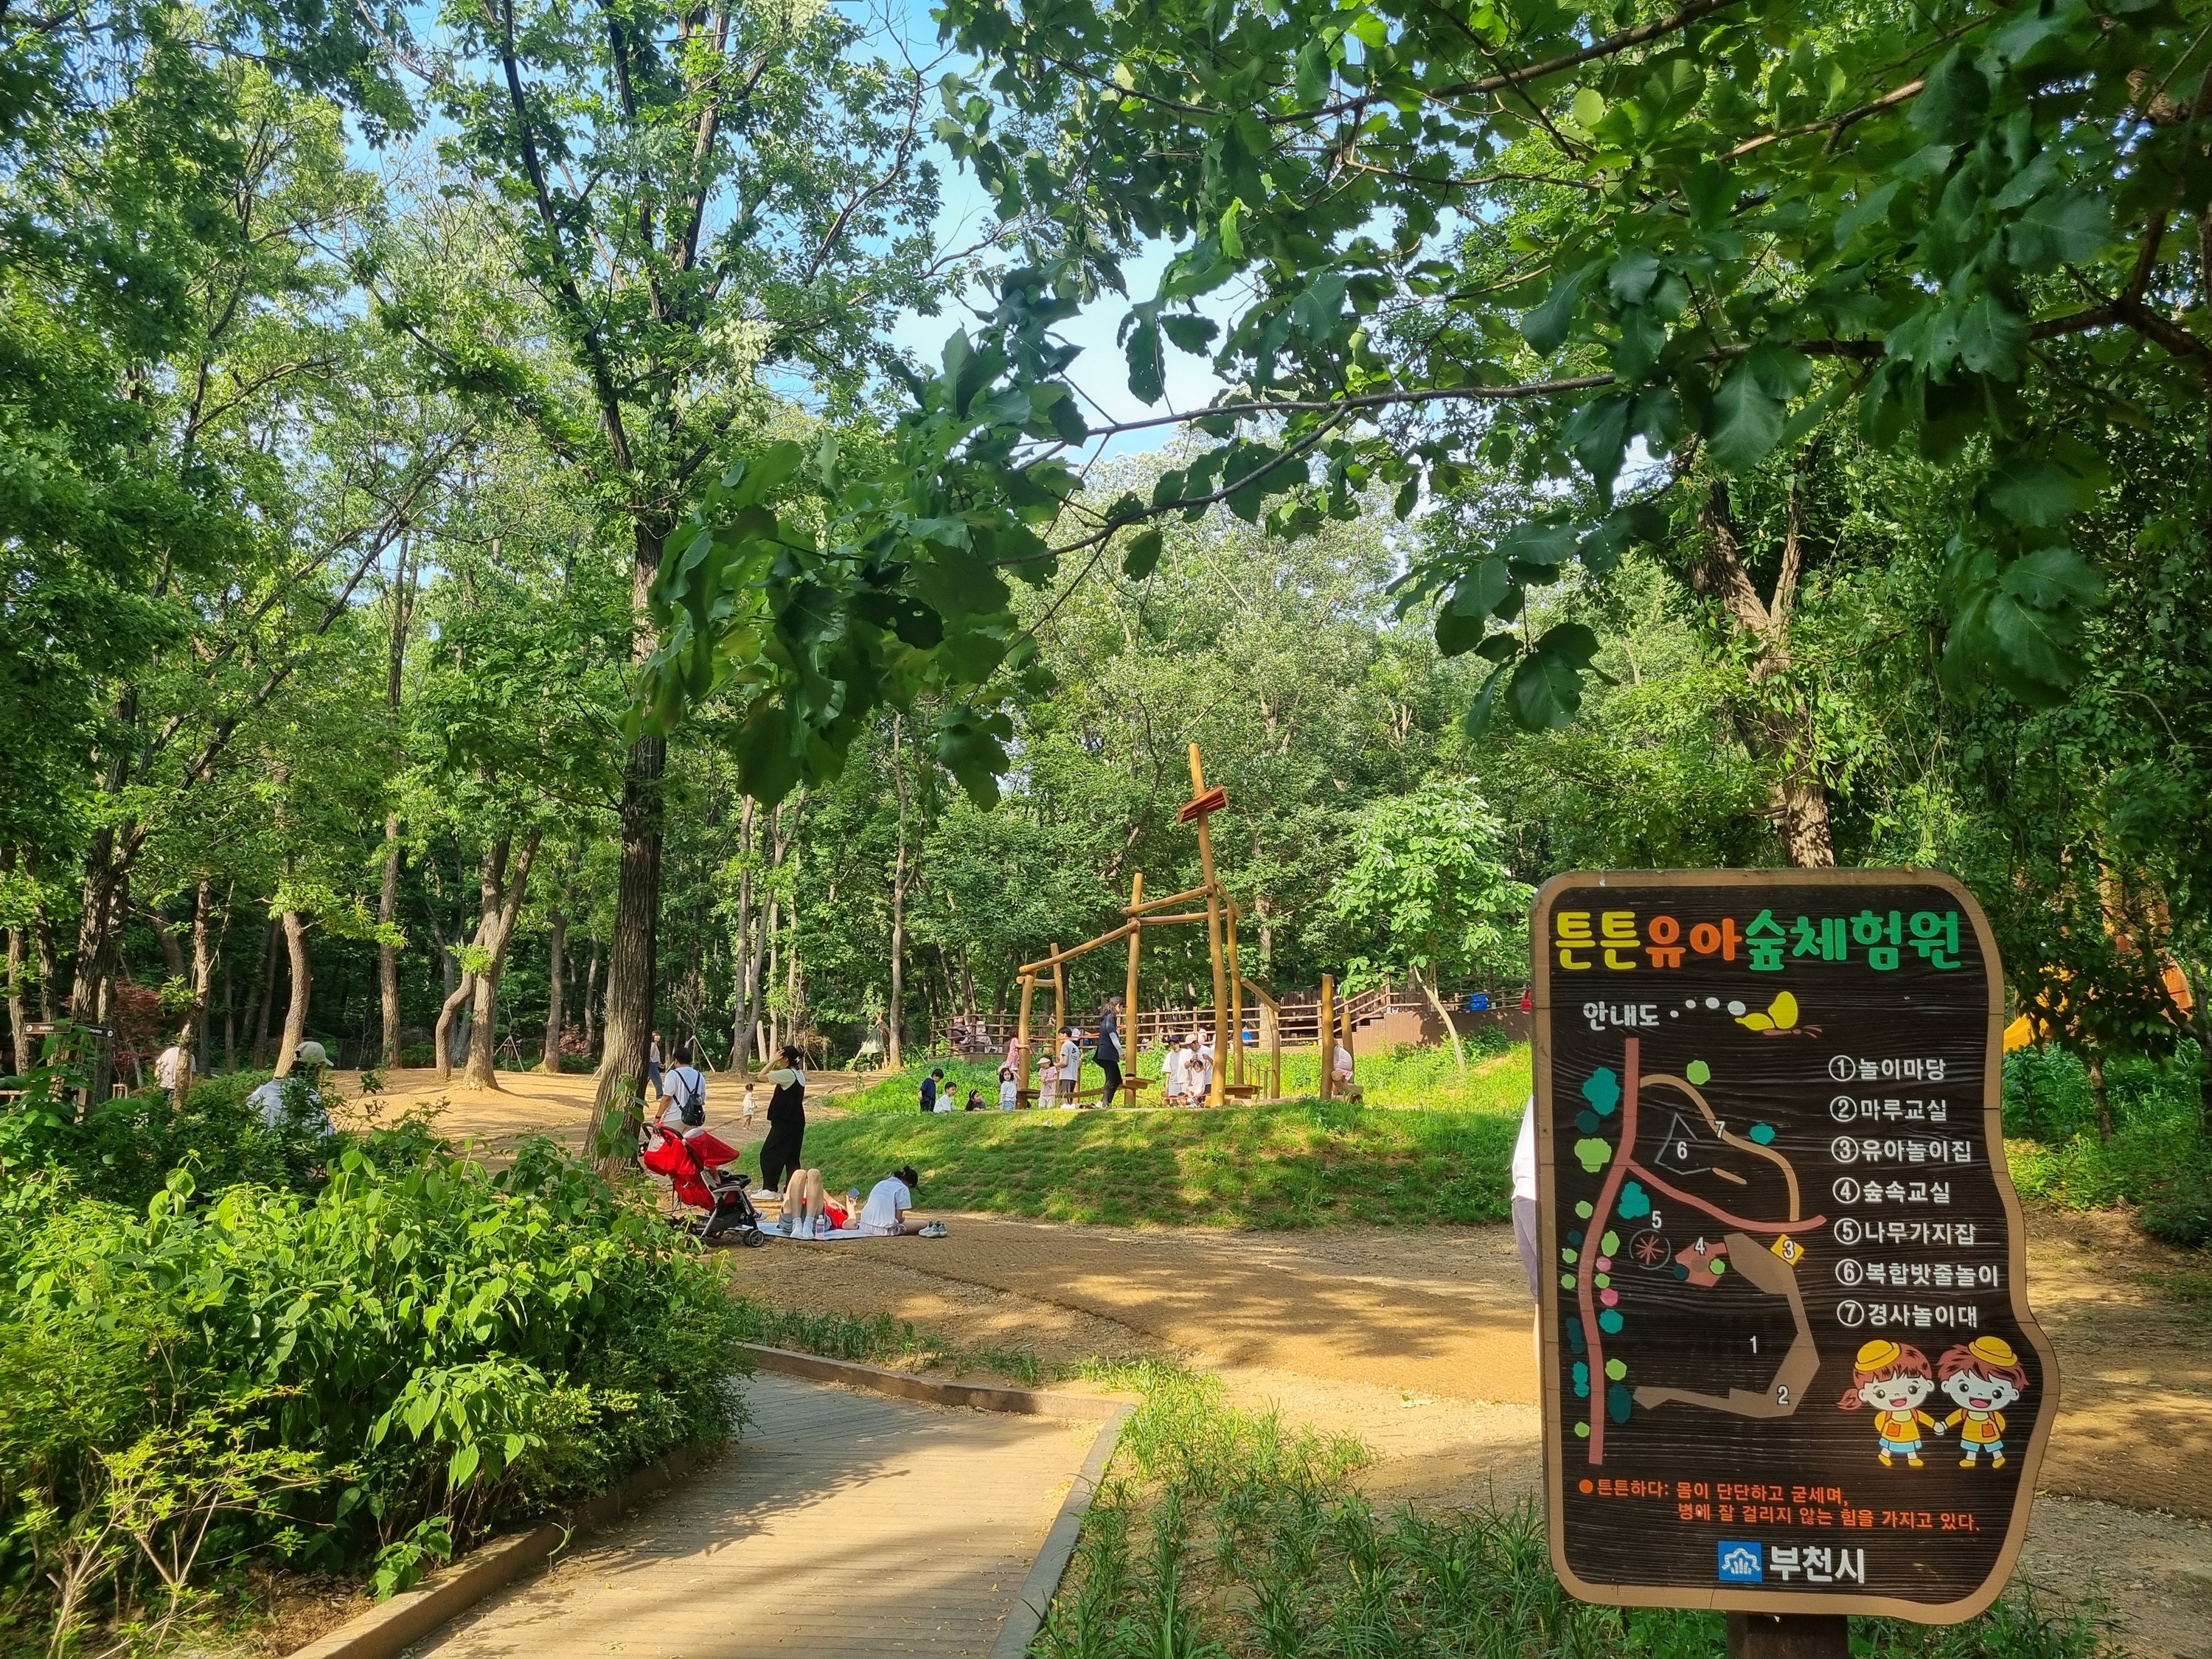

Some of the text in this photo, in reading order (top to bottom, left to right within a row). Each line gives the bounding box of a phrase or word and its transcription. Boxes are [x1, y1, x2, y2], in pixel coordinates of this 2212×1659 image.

[1583, 1001, 1660, 1031] 안내도
[1858, 1058, 1946, 1081] 놀이마당
[1860, 1099, 1947, 1121] 마루교실
[1715, 1121, 1725, 1138] 7
[1677, 1141, 1688, 1159] 6
[1861, 1139, 1971, 1163] 유아놀이집
[1863, 1180, 1950, 1203] 숲속교실
[1652, 1210, 1662, 1228] 5
[1694, 1237, 1705, 1256] 4
[1784, 1240, 1794, 1259] 3
[1865, 1262, 1998, 1287] 복합밧줄놀이
[1868, 1304, 1977, 1328] 경사놀이대
[1750, 1335, 1757, 1354] 1
[1778, 1385, 1789, 1405] 2
[1596, 1479, 1848, 1507] 튼튼하다: 몸이 단단하고 굳세며,
[1678, 1503, 1980, 1531] 병에 잘 걸리지 않는 힘을 가지고 있다.
[1770, 1545, 1865, 1584] 부천시
